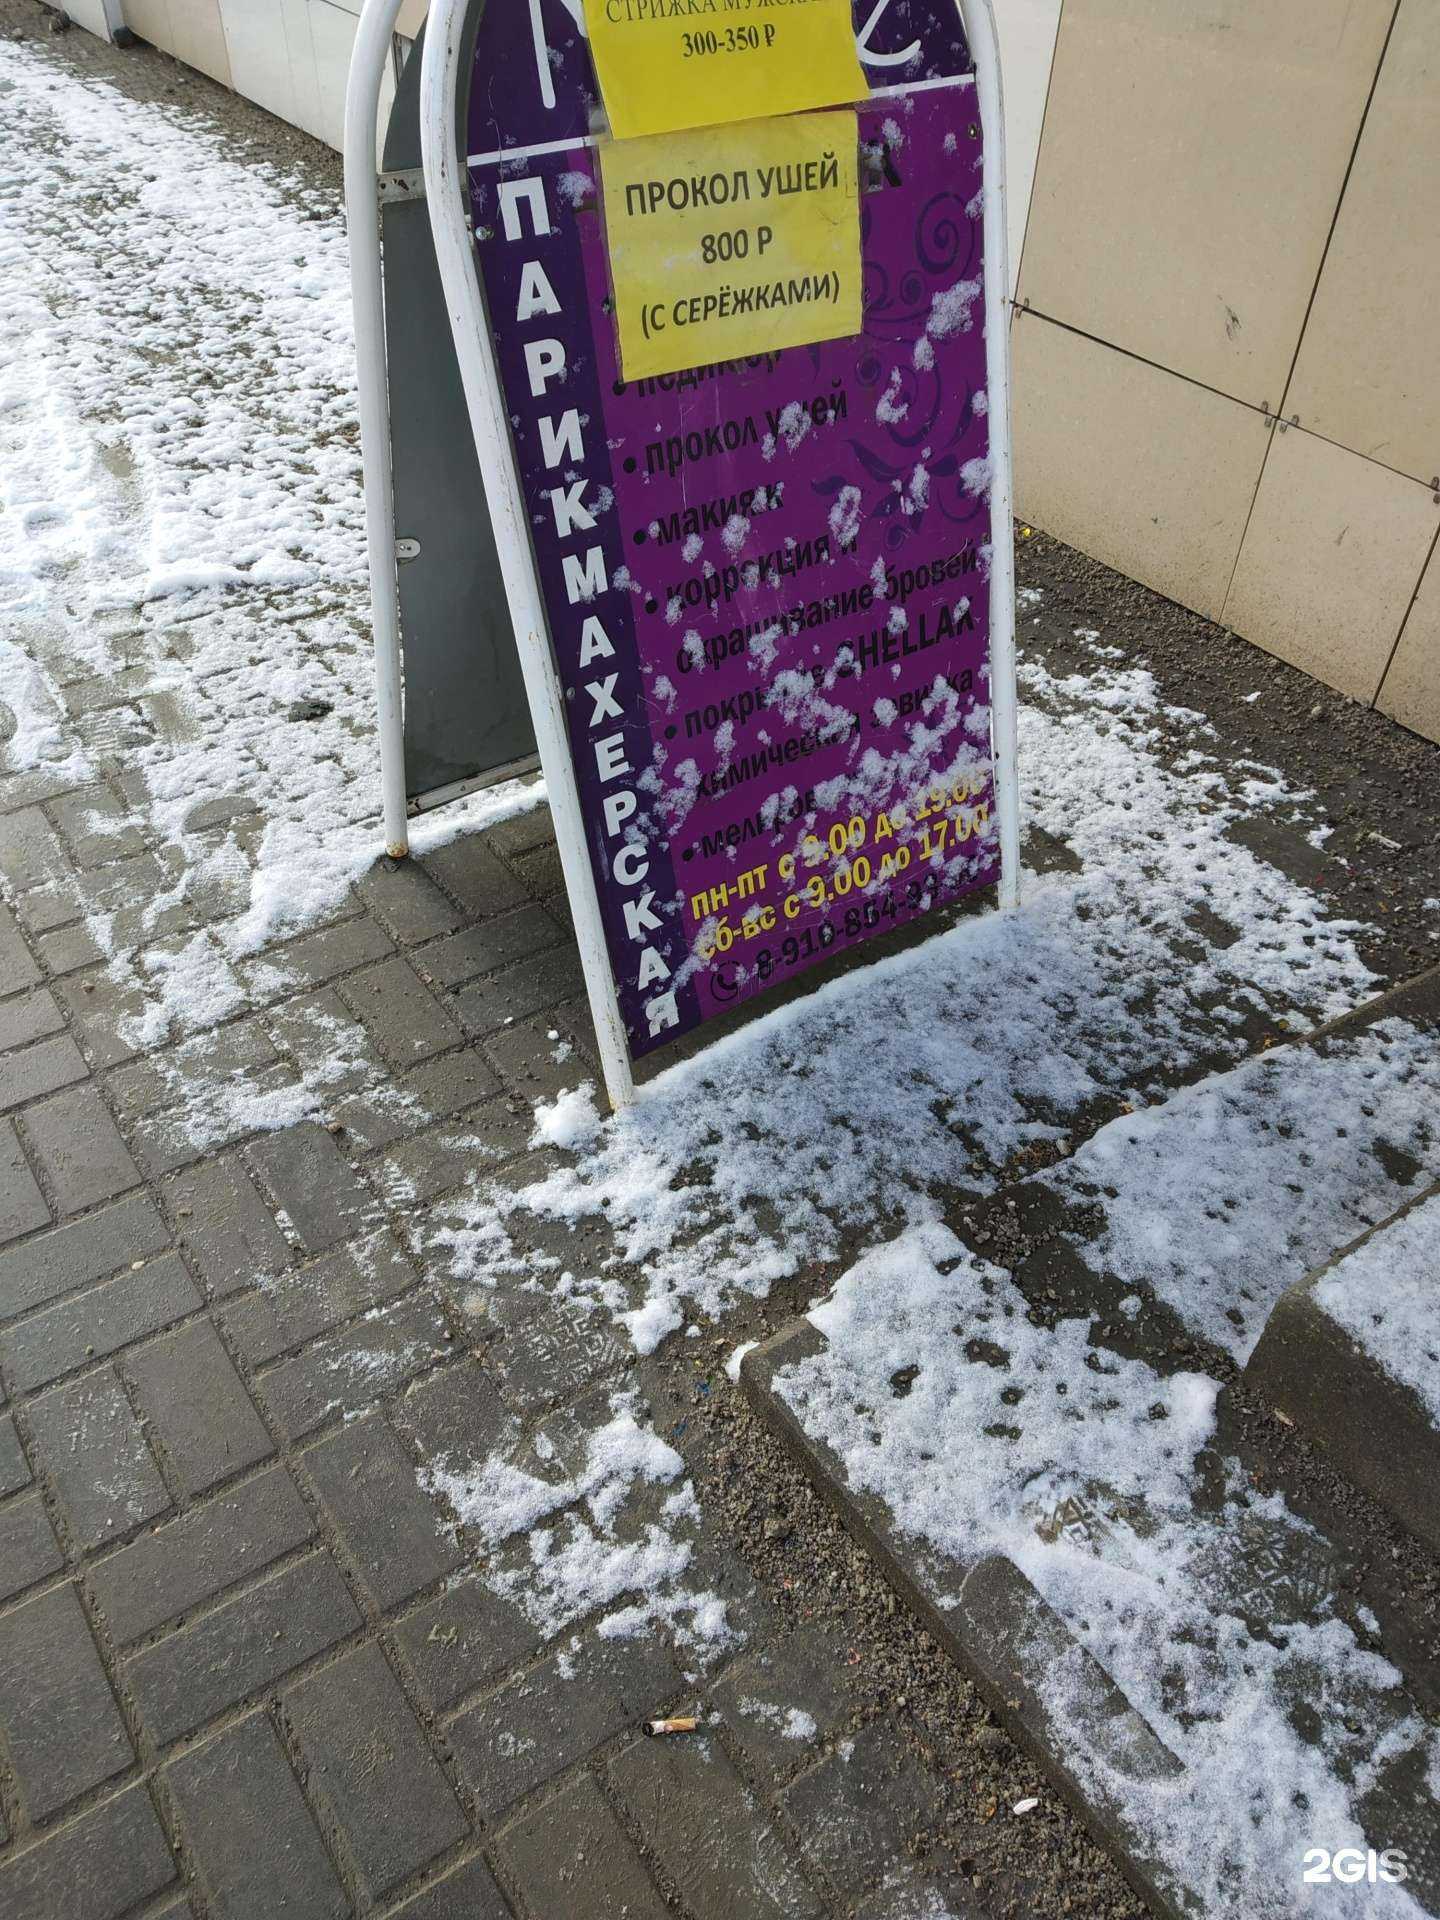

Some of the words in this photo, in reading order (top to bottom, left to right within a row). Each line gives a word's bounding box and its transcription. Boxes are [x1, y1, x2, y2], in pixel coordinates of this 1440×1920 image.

[606, 0, 716, 24] СТРИЖКА
[682, 25, 760, 58] 300-350
[625, 177, 751, 217] ПРОКОЛ
[759, 152, 839, 198] УШЕЙ
[700, 229, 749, 265] 800
[641, 302, 669, 340] (С
[673, 272, 841, 328] СЕРЁЖКАМИ)
[646, 416, 759, 477] прокол
[765, 377, 849, 445] уей
[496, 176, 680, 1038] ПАРИКМАХЕРСКАЯ
[676, 583, 873, 674] оравание
[884, 538, 977, 602] бровей
[684, 664, 825, 738] покрые
[690, 863, 769, 920] пн-пт
[778, 852, 797, 880] с
[783, 892, 801, 919] с
[804, 856, 872, 908] 9.00
[878, 845, 911, 883] до
[919, 803, 989, 861] 17.00
